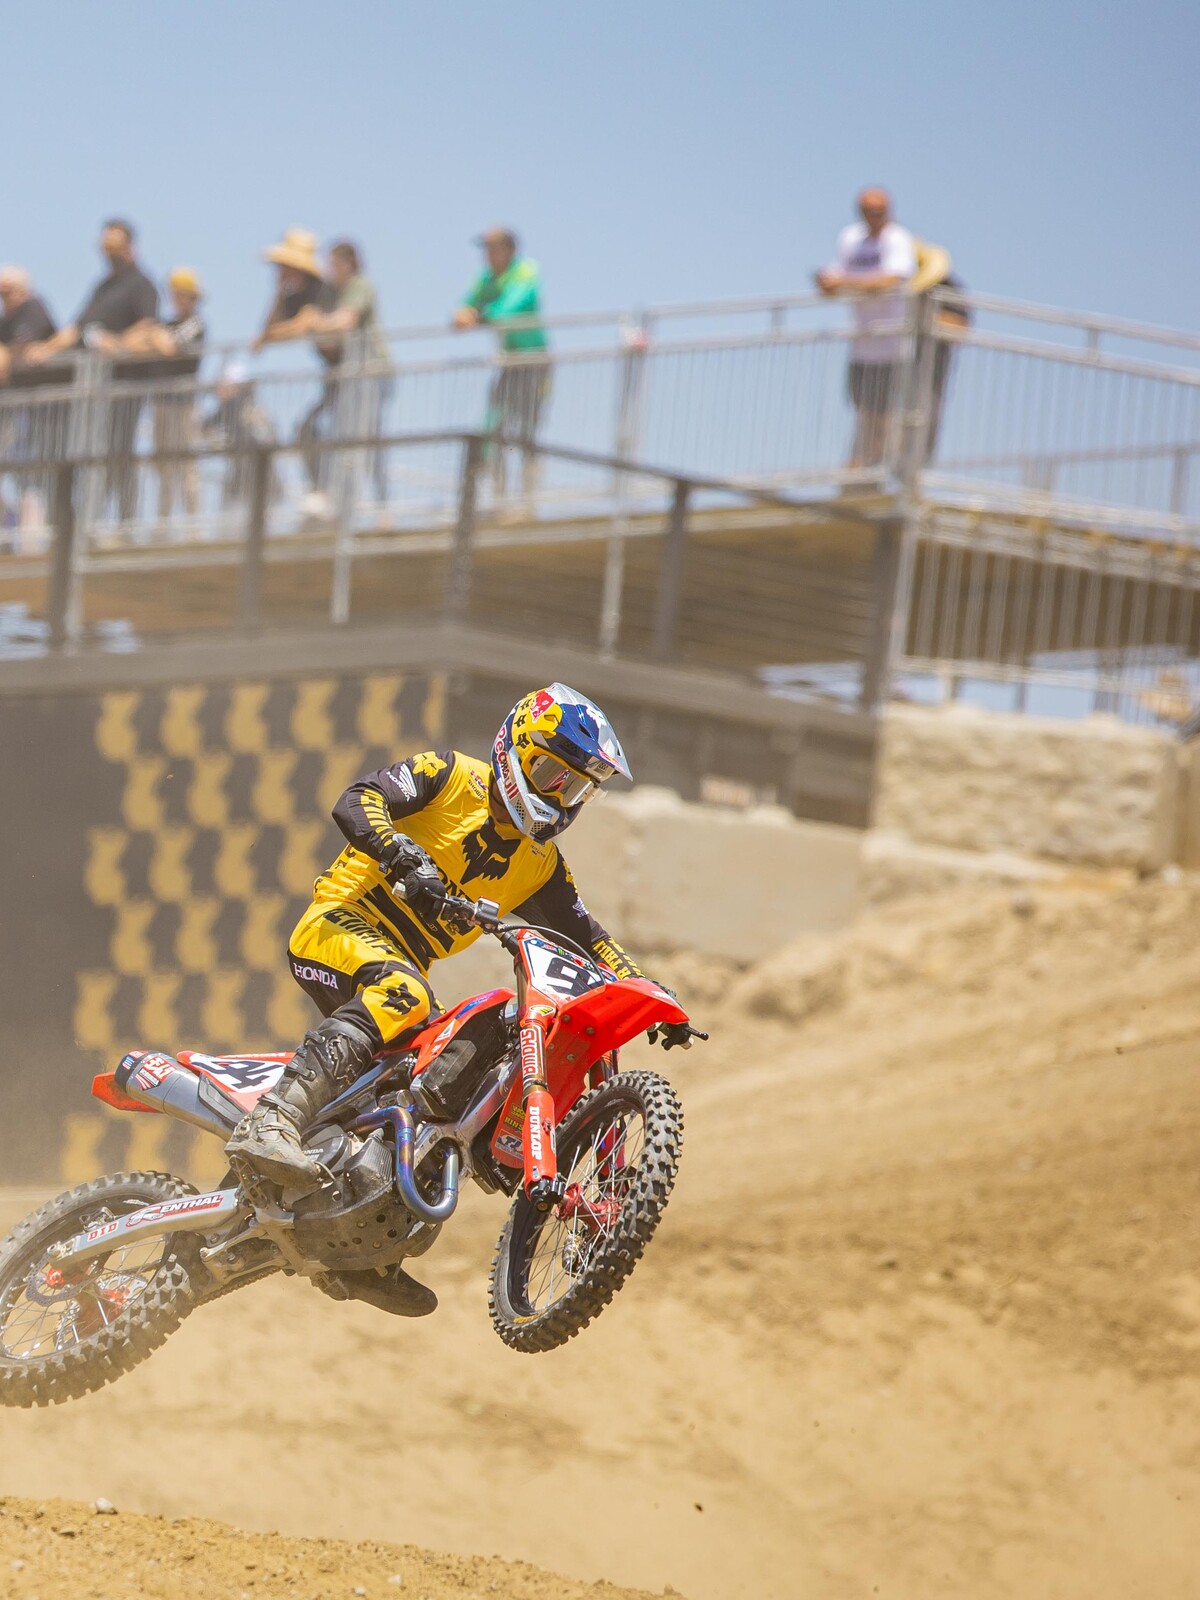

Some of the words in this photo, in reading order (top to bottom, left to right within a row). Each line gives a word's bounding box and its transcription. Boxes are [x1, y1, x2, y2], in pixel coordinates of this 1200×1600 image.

[293, 962, 338, 990] HONDA
[520, 1029, 538, 1078] SHOWA
[529, 1105, 542, 1160] DUNLOP
